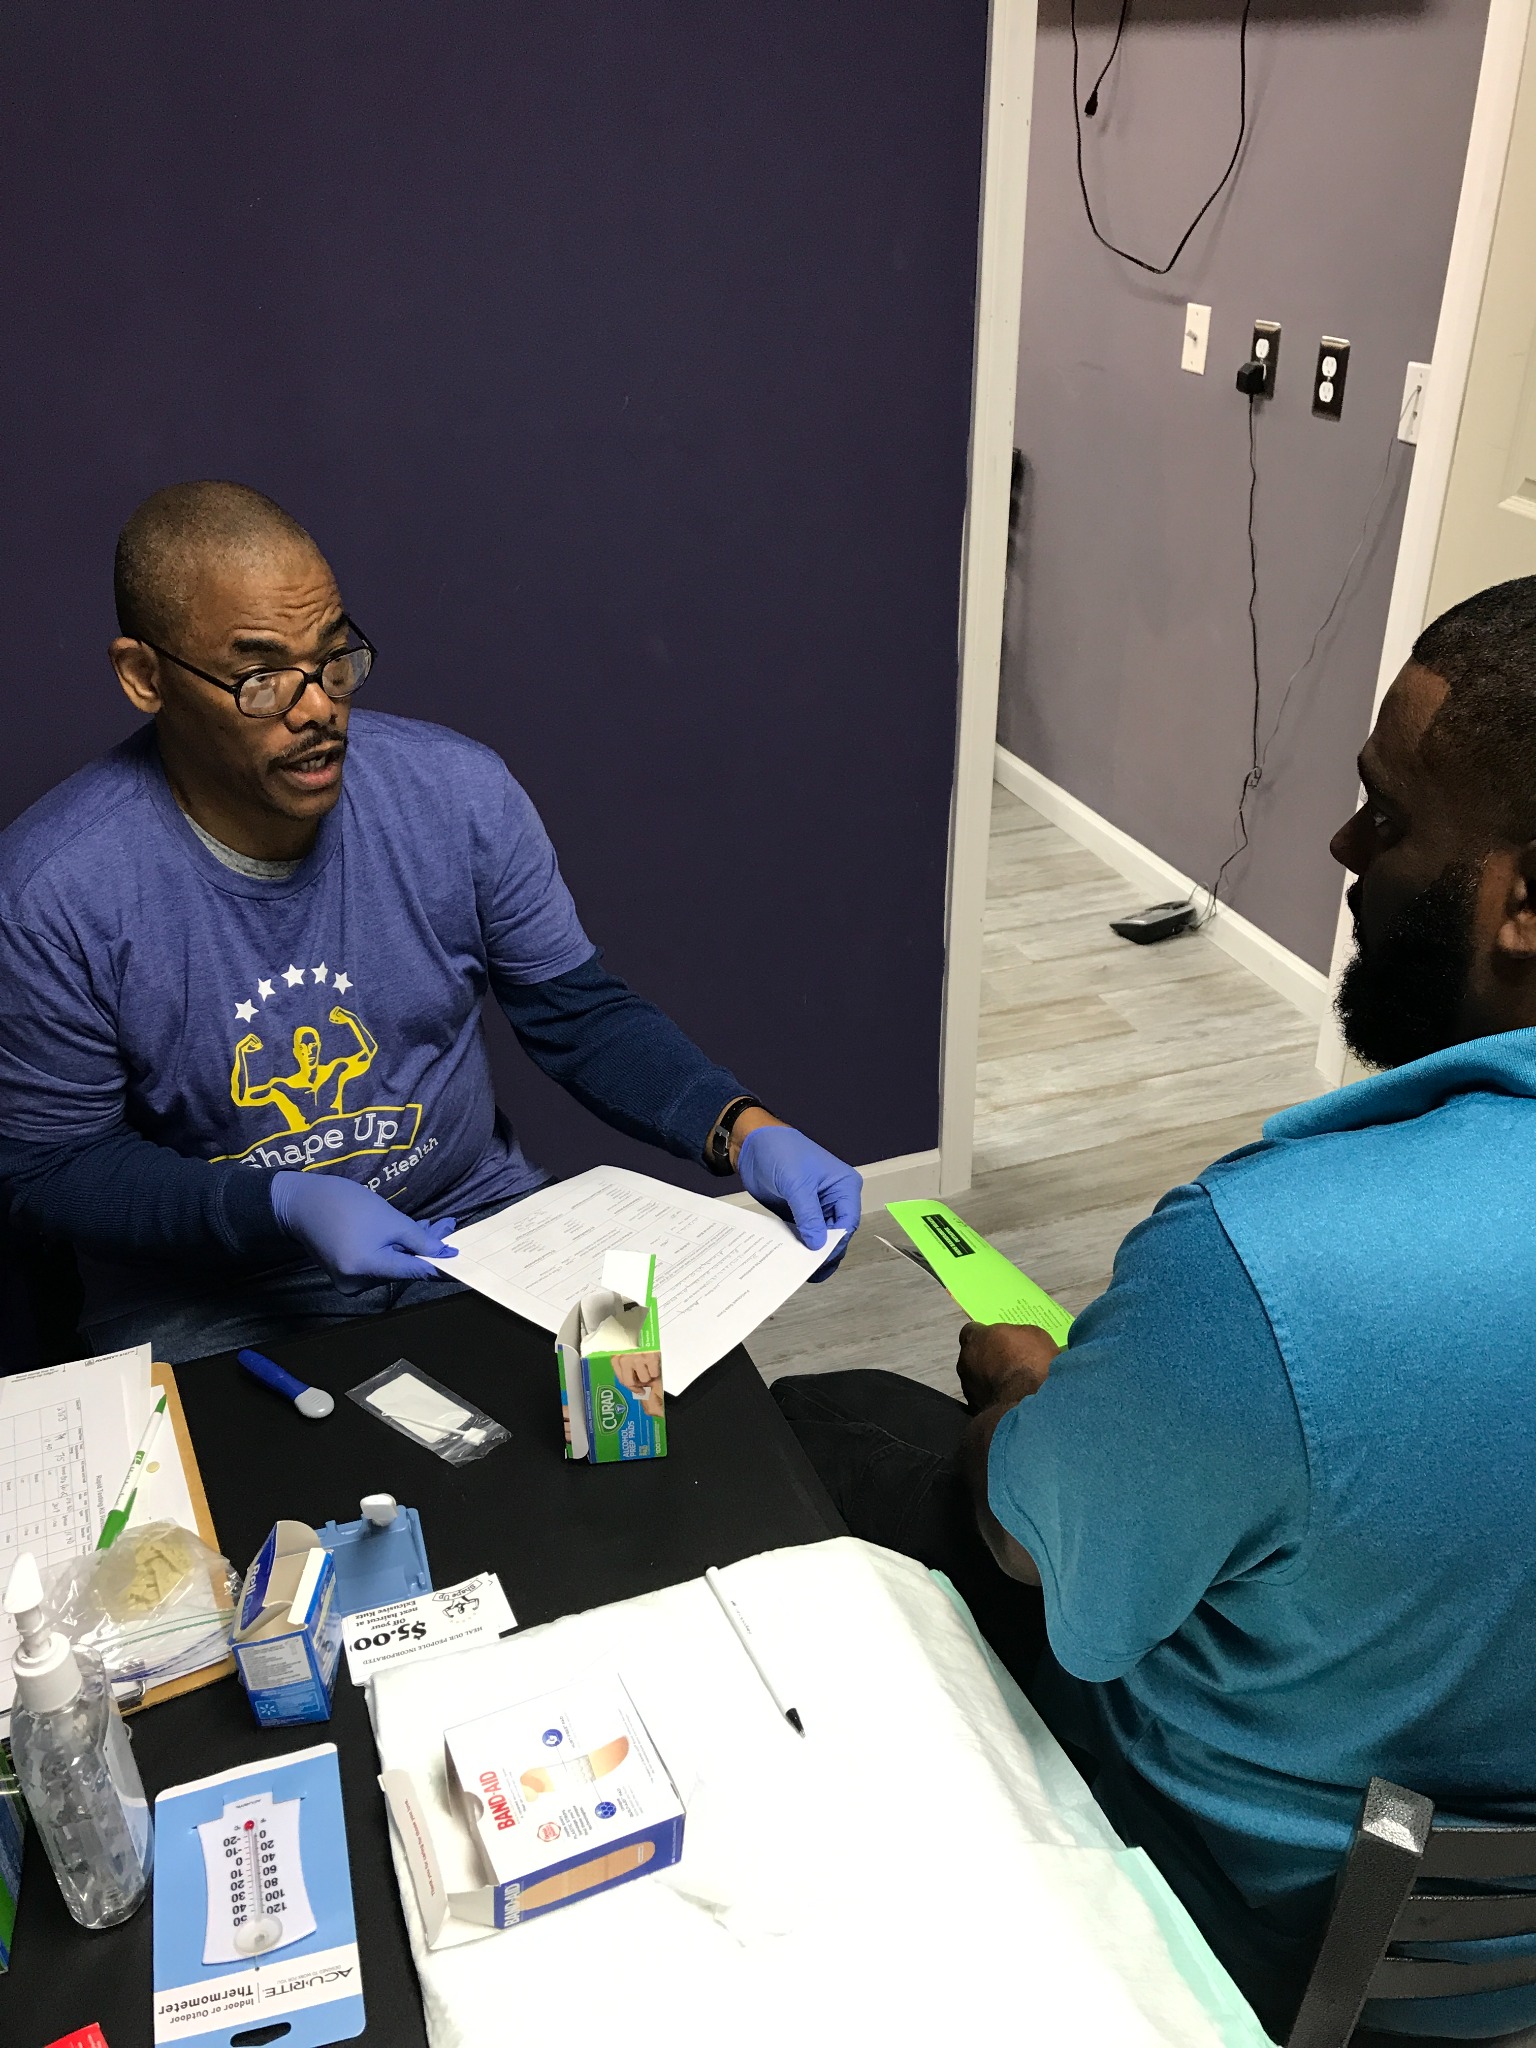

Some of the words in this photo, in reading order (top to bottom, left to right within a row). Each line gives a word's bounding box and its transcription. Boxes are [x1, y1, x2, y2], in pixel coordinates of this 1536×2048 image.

[354, 1113, 398, 1147] Up
[383, 1136, 438, 1183] Health
[601, 1390, 617, 1429] CURAD
[627, 1421, 636, 1438] PADS
[621, 1428, 630, 1457] ALCOHOL
[628, 1440, 637, 1456] PREP
[95, 1475, 103, 1489] Rapid
[96, 1490, 104, 1507] Testing
[98, 1506, 106, 1515] Kit
[452, 1584, 475, 1597] Shape
[439, 1592, 449, 1602] Up
[356, 1611, 375, 1620] Kutz
[400, 1606, 418, 1616] next
[367, 1613, 397, 1624] haircut
[393, 1617, 405, 1627] Off
[371, 1621, 390, 1630] your
[466, 1626, 482, 1636] HEAL
[354, 1621, 426, 1650] $5.00
[449, 1632, 463, 1641] OUR
[363, 1648, 416, 1664] INCORPORATED
[480, 1771, 516, 1830] BAND-AID
[259, 1829, 267, 1839] 0
[224, 1836, 240, 1847] -20
[261, 1840, 274, 1850] 20
[226, 1848, 242, 1857] -10
[235, 1857, 243, 1866] 0
[262, 1854, 275, 1863] 40
[231, 1869, 243, 1879] 10
[263, 1865, 276, 1876] 60
[231, 1880, 244, 1891] 20
[264, 1878, 278, 1888] 80
[232, 1892, 245, 1902] 30
[266, 1889, 284, 1901] 100
[232, 1904, 246, 1914] 40
[267, 1902, 286, 1914] 120
[504, 1883, 520, 1927] BAND-AID
[159, 1986, 253, 2014] Thermometer
[224, 1998, 254, 2010] Indoor
[211, 2006, 221, 2014] or
[170, 2010, 208, 2023] Outdoor
